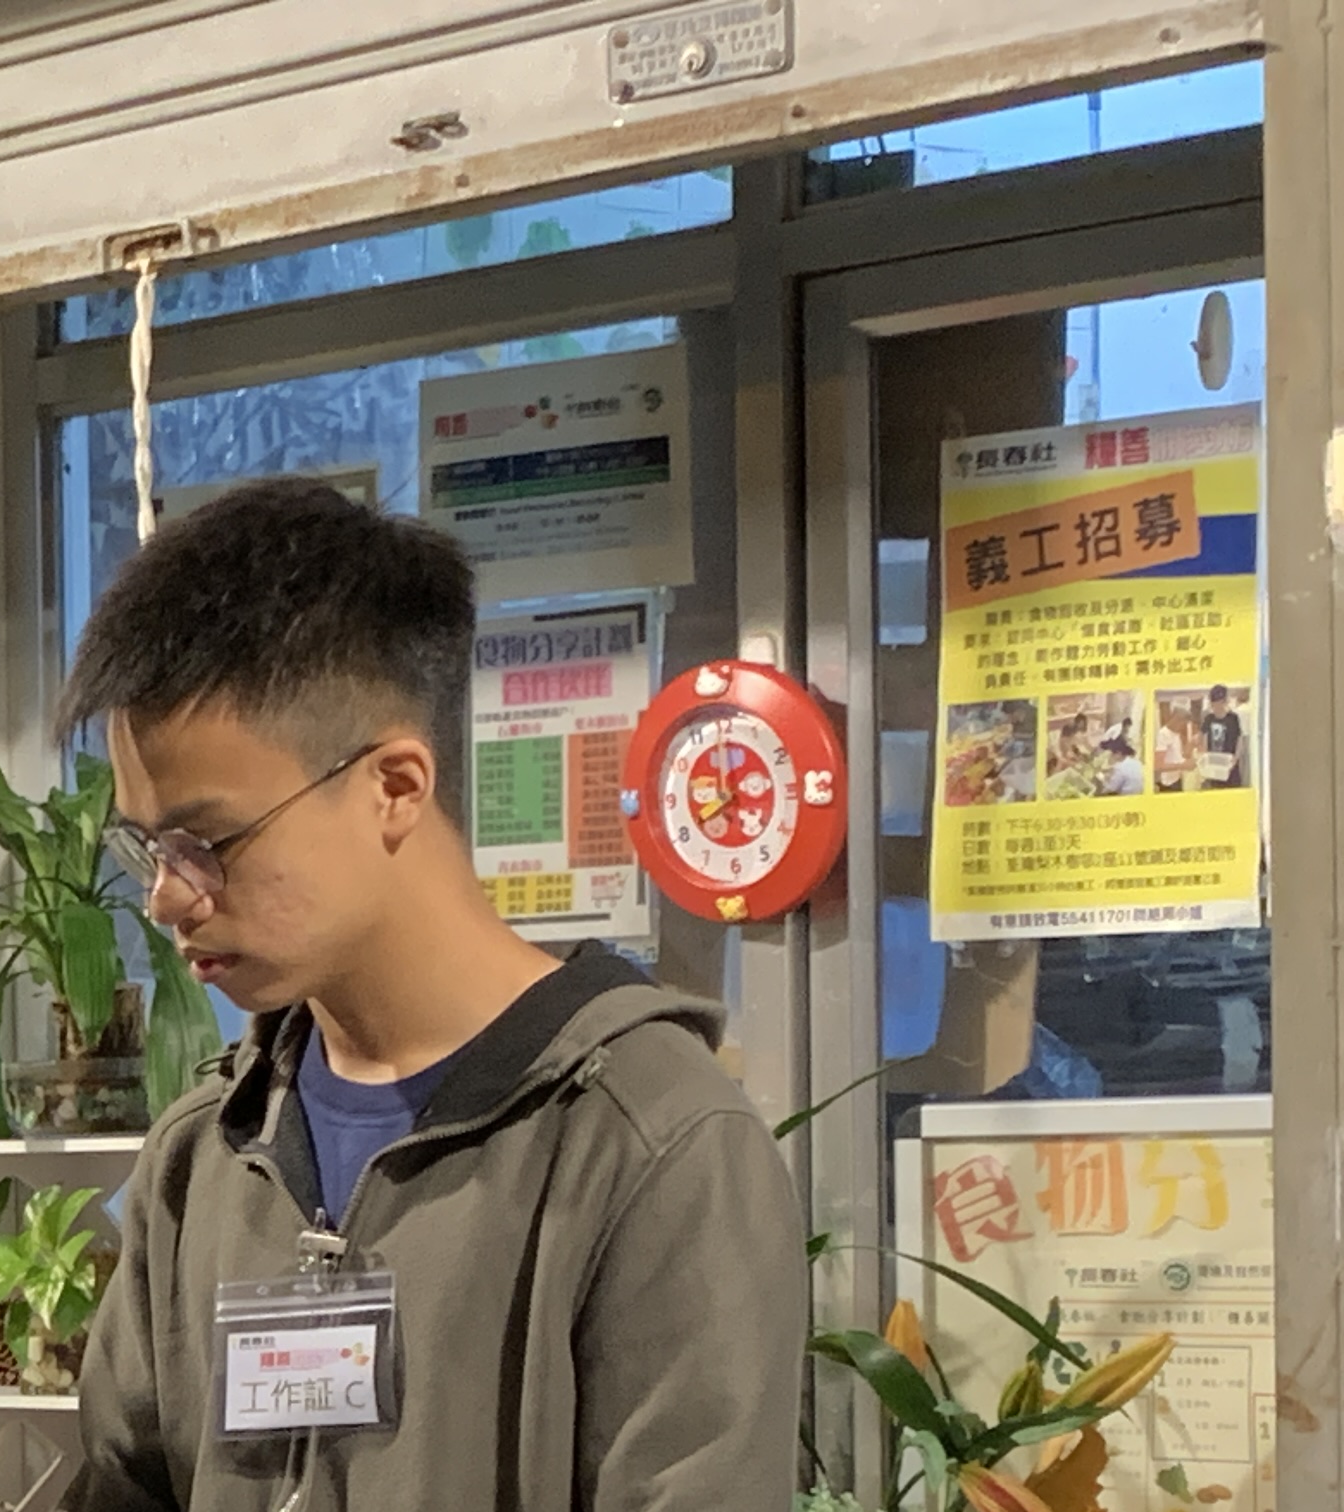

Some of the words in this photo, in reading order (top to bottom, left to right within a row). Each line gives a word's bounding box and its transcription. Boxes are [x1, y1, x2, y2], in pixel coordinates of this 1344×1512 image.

[976, 441, 1056, 470] 長春社
[964, 493, 1182, 592] 義工招募
[475, 622, 634, 669] 食物分享計劃
[678, 826, 690, 842] 8
[730, 857, 741, 875] 6
[759, 845, 770, 861] 5
[239, 1377, 336, 1414] 工作証
[345, 1380, 366, 1409] C
